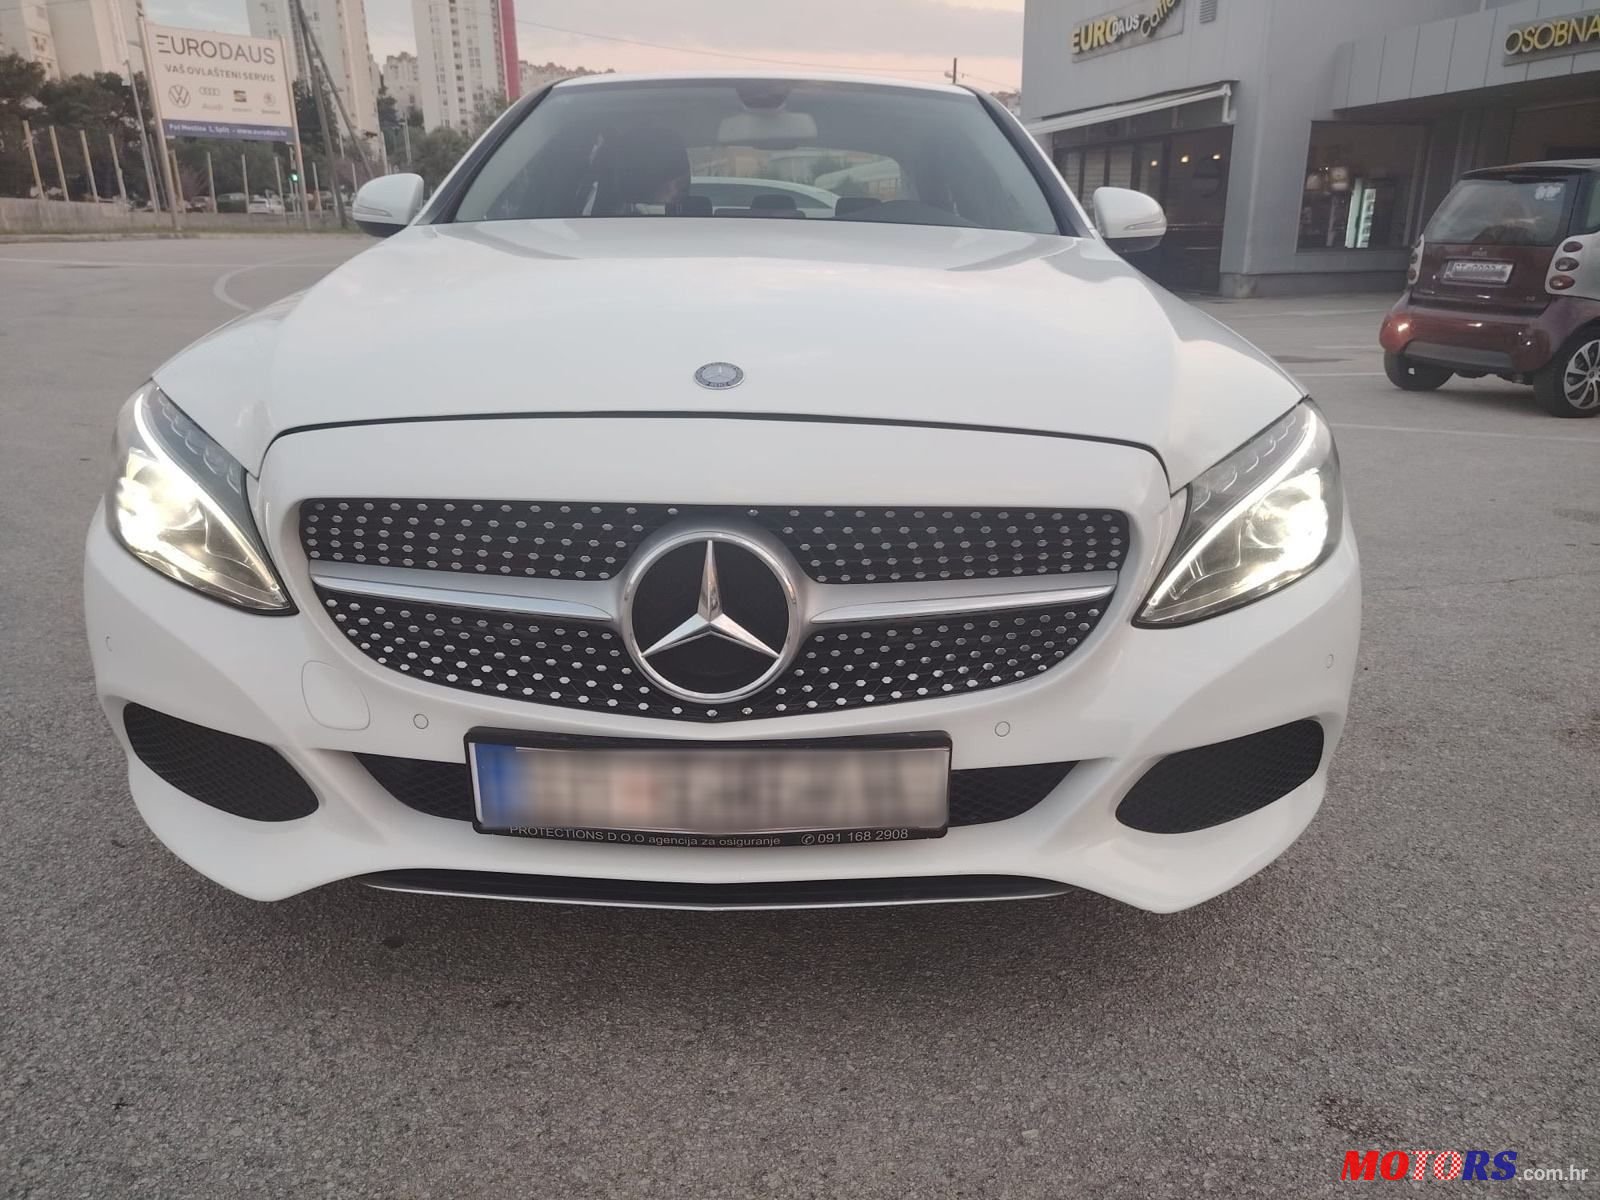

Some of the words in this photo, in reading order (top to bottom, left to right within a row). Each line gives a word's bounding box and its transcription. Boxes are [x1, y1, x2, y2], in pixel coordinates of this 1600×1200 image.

[1504, 14, 1600, 55] OSOBNA
[156, 34, 276, 65] EURODAUS
[165, 63, 185, 74] VAŠ
[242, 72, 276, 82] SERVIS
[510, 825, 604, 841] PROTECTIONS
[648, 834, 698, 847] agencija
[701, 838, 716, 846] za
[719, 836, 781, 848] osiguranje
[817, 833, 841, 844] 091
[848, 831, 871, 842] 168
[875, 828, 909, 841] 2908
